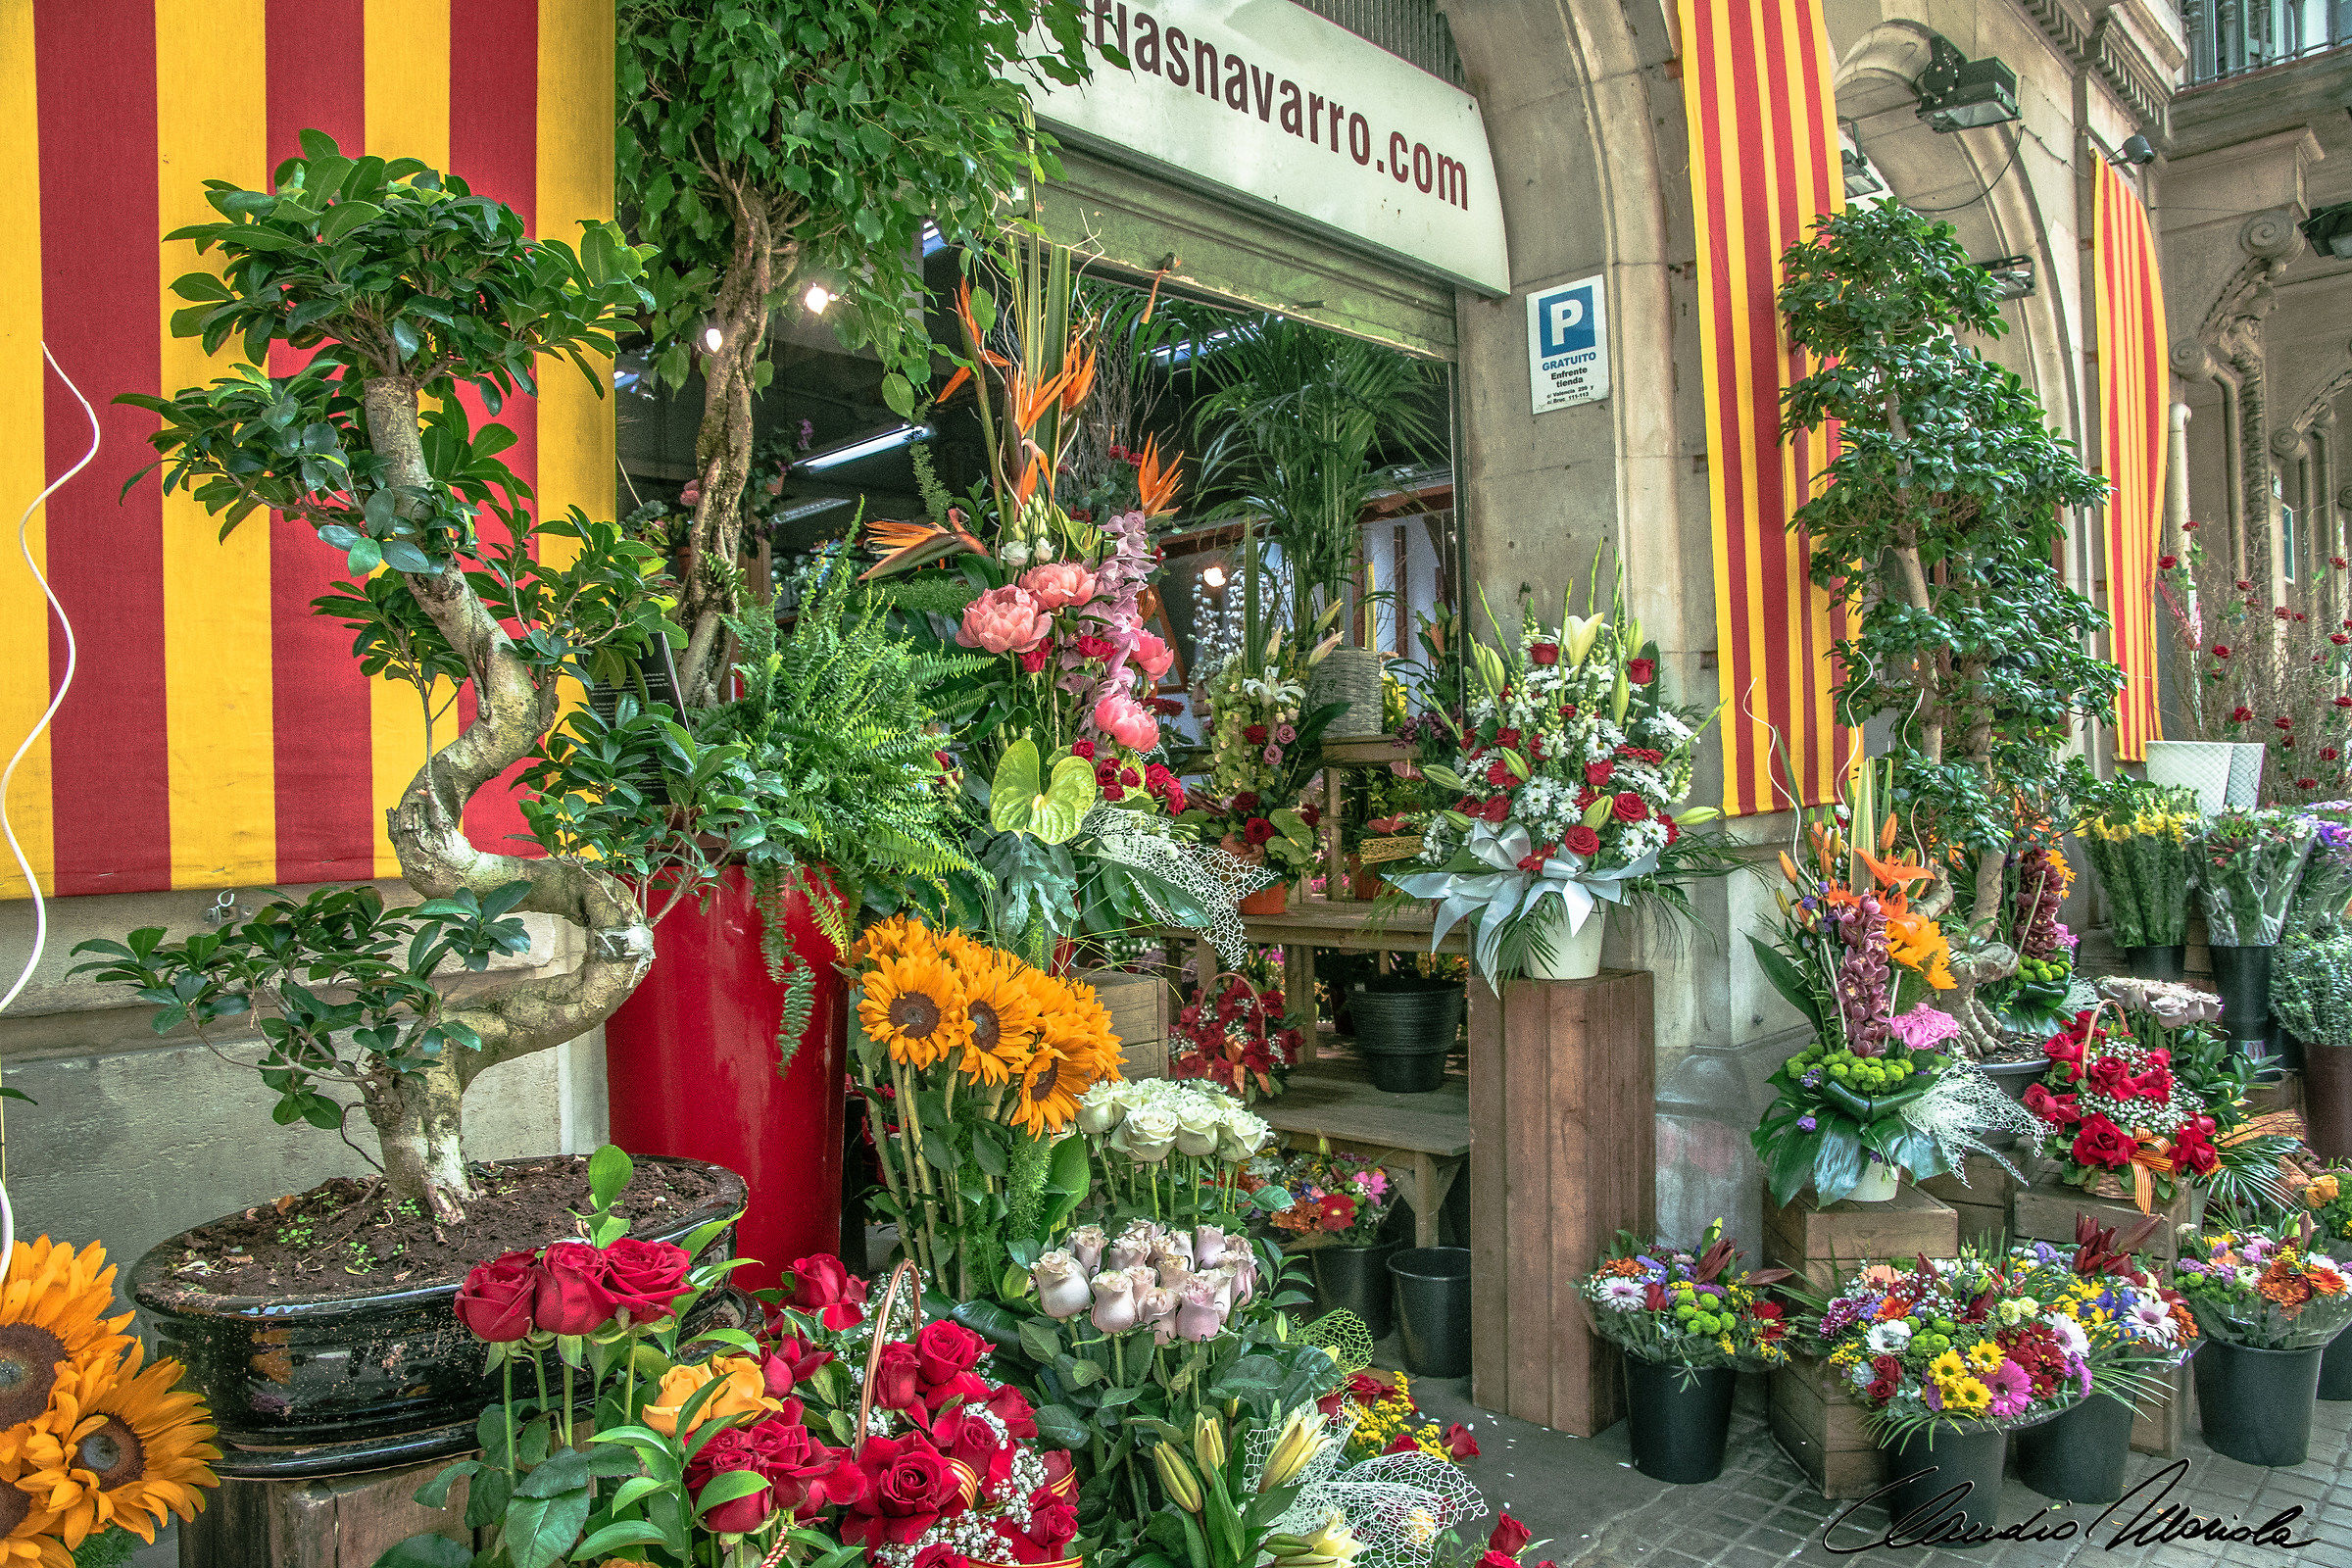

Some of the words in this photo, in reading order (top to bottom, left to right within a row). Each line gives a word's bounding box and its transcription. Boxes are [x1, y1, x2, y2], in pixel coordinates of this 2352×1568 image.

[1080, 0, 1468, 212] riasnavarro.com
[1549, 299, 1584, 347] P
[1542, 351, 1596, 371] GRATUITO
[1550, 367, 1588, 380] Enfrente
[1556, 376, 1584, 388] tienda
